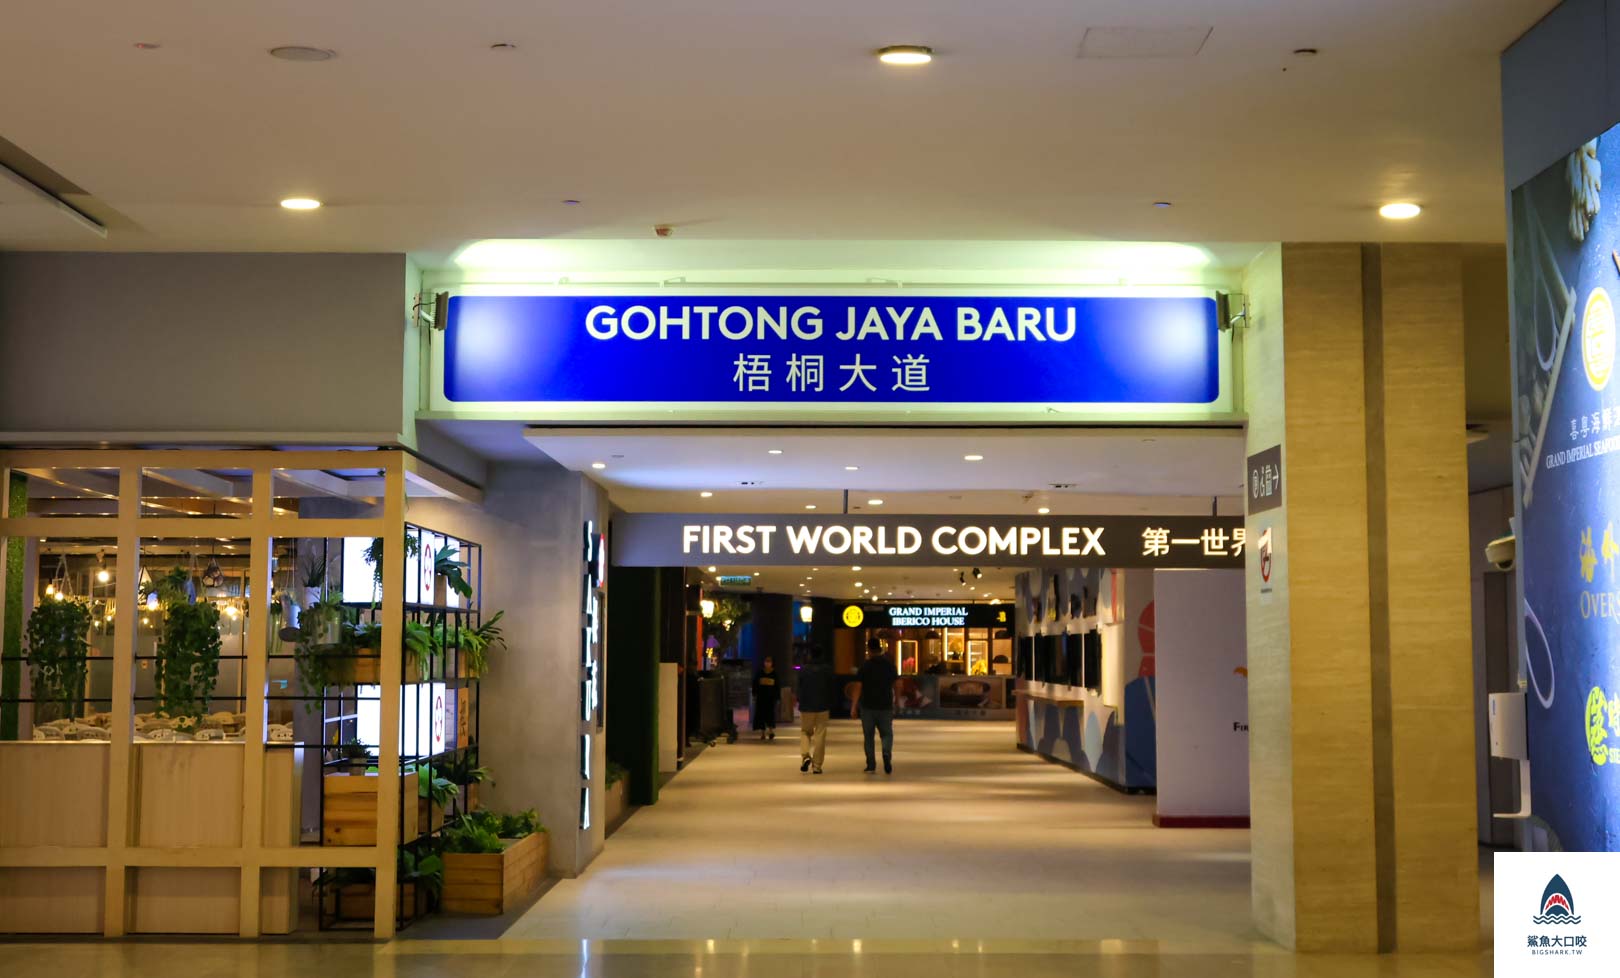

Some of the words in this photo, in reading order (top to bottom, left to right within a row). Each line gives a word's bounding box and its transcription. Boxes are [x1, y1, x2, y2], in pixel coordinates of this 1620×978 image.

[585, 304, 823, 341] GOHTONG
[835, 306, 944, 341] JAYA
[957, 306, 1077, 342] BARU
[732, 352, 931, 392] 梧桐大道
[1546, 451, 1566, 470] GRAND
[1566, 442, 1594, 464] IMPERIAL
[682, 525, 777, 554] FIRST
[785, 526, 922, 555] WORLD
[931, 526, 1106, 556] COMPLEX
[888, 606, 923, 617] GRAND
[923, 606, 968, 617] IMPERIAL
[891, 616, 931, 626] IBERICO
[931, 616, 966, 626] HOUSE
